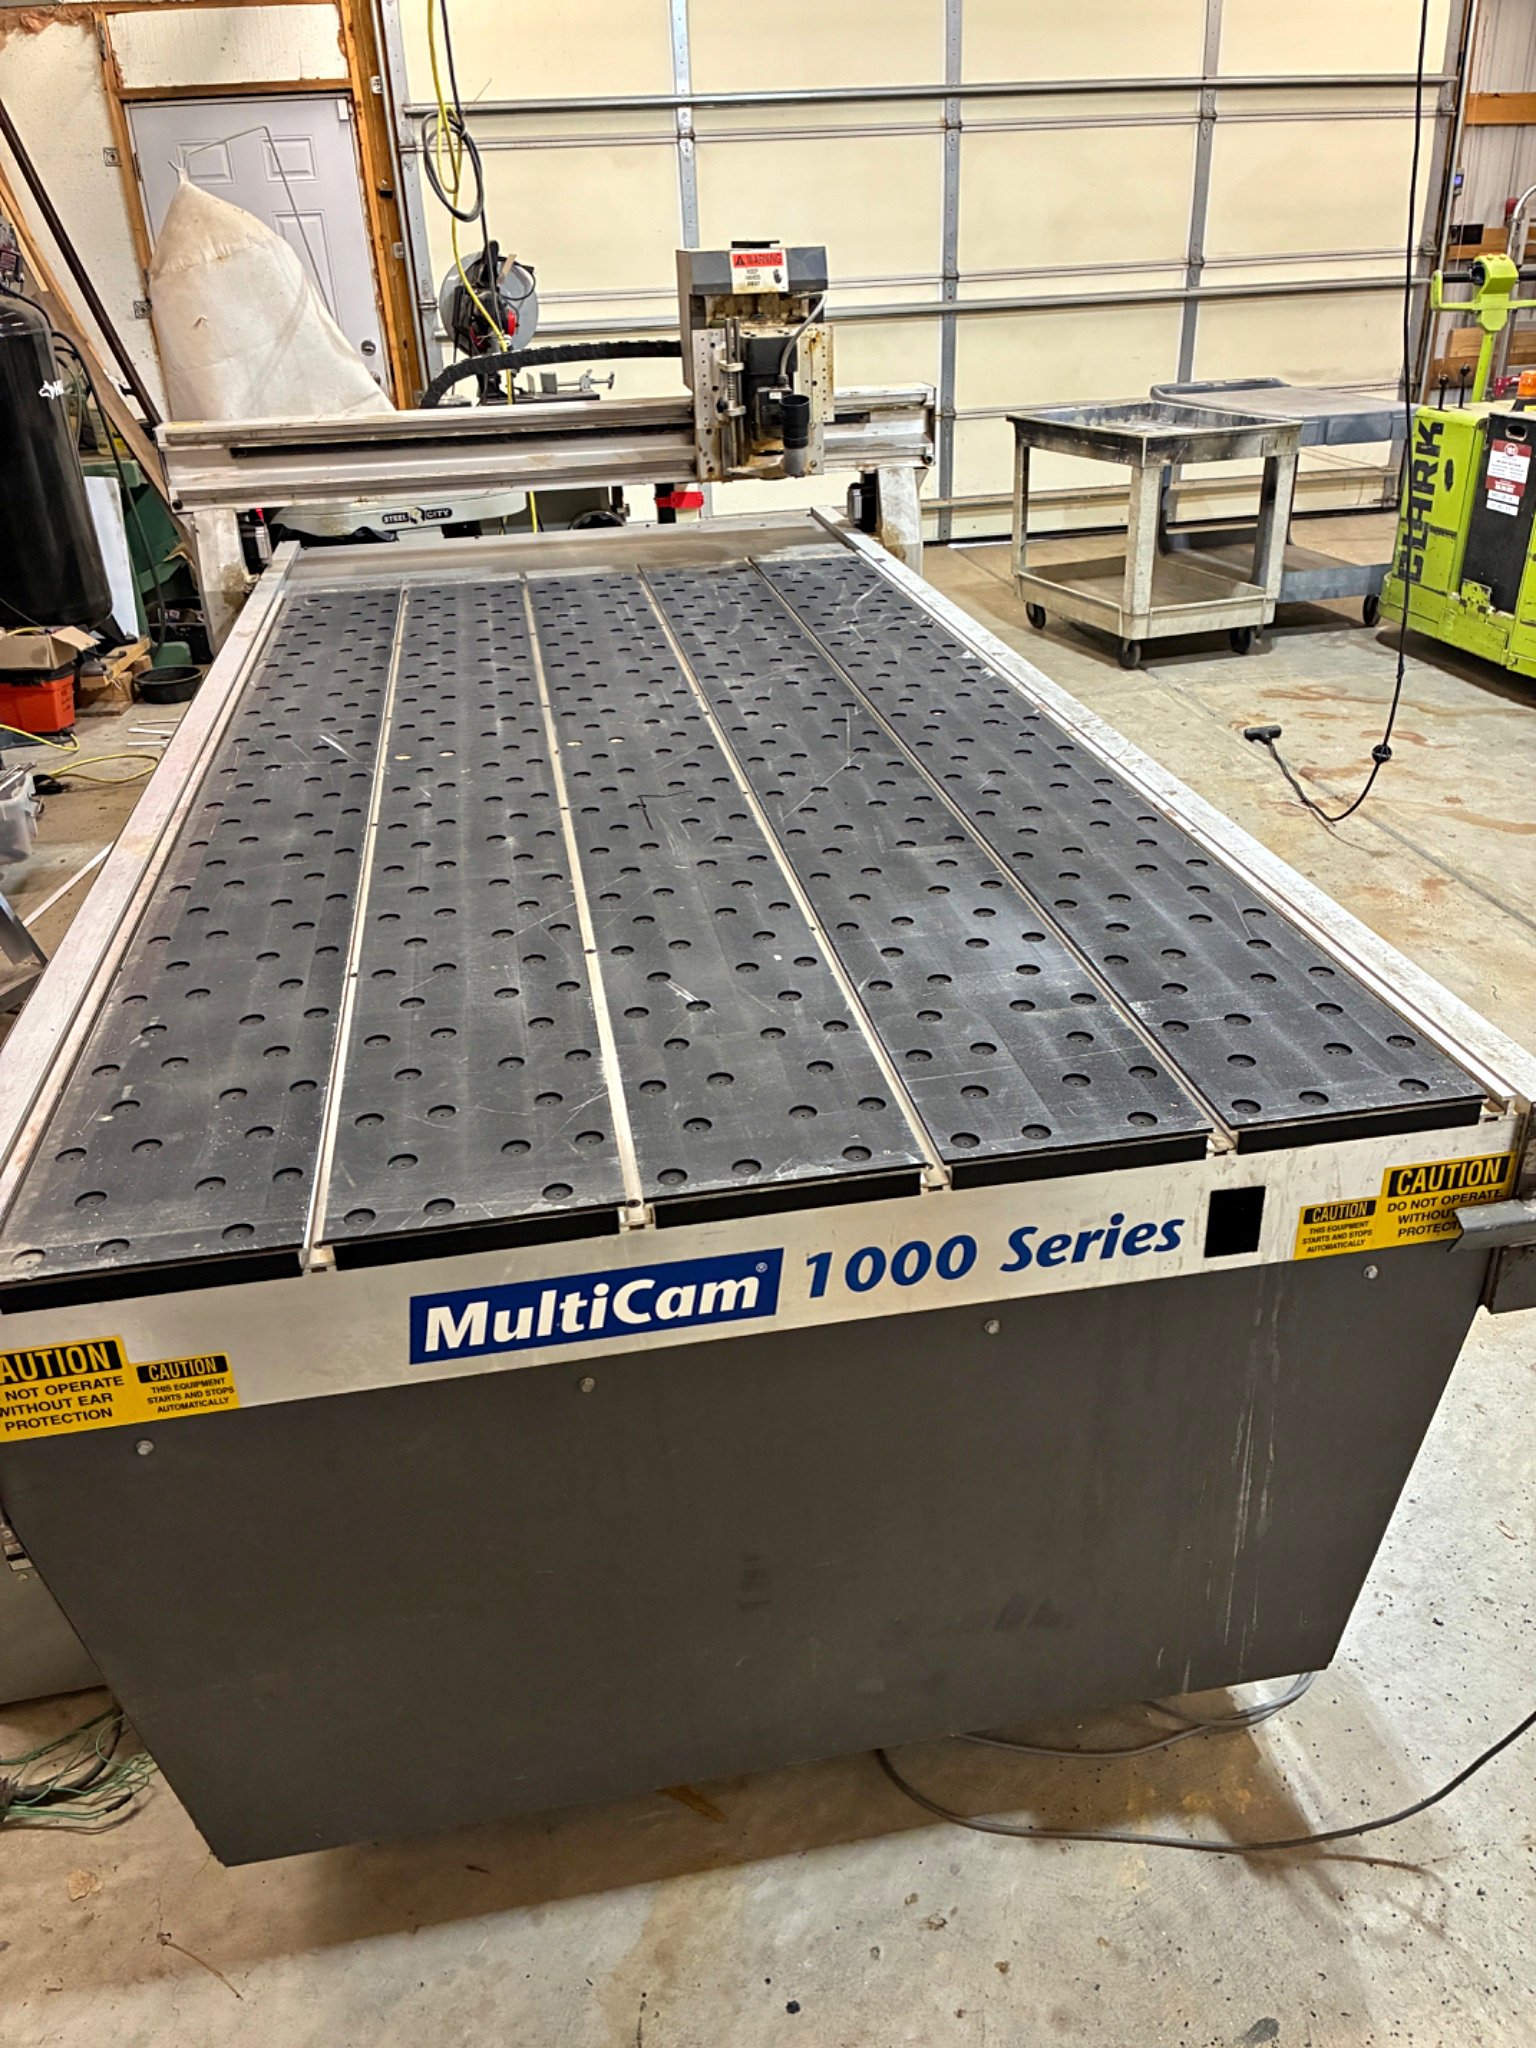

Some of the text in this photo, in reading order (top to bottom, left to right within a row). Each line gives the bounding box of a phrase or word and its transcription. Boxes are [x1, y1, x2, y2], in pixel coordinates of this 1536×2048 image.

[1398, 420, 1445, 583] CLARK
[384, 510, 450, 523] STEEL CITY
[1397, 1158, 1502, 1195] CAUTION
[1388, 1190, 1504, 1212] DO NOT OPERATE
[1313, 1202, 1368, 1222] CAUTION
[1328, 1221, 1369, 1231] EQUIPMENT
[1398, 1220, 1462, 1237] PROTECT
[1302, 1229, 1373, 1244] STARTS AND STOPS
[1307, 1240, 1366, 1253] AUTOMATICALLY
[424, 1213, 1185, 1352] MultiCam 1000 Series
[0, 1343, 111, 1383] AUTION
[149, 1358, 217, 1381] CAUTION
[5, 1376, 125, 1401] NOT OPERATE
[151, 1377, 225, 1393] THIS EQUIPMENT
[78, 1393, 113, 1406] EAR
[147, 1386, 235, 1404] STARTS AND STOPS
[157, 1397, 229, 1413] AUTOMATICALLY
[5, 1408, 113, 1432] PROTECTION
